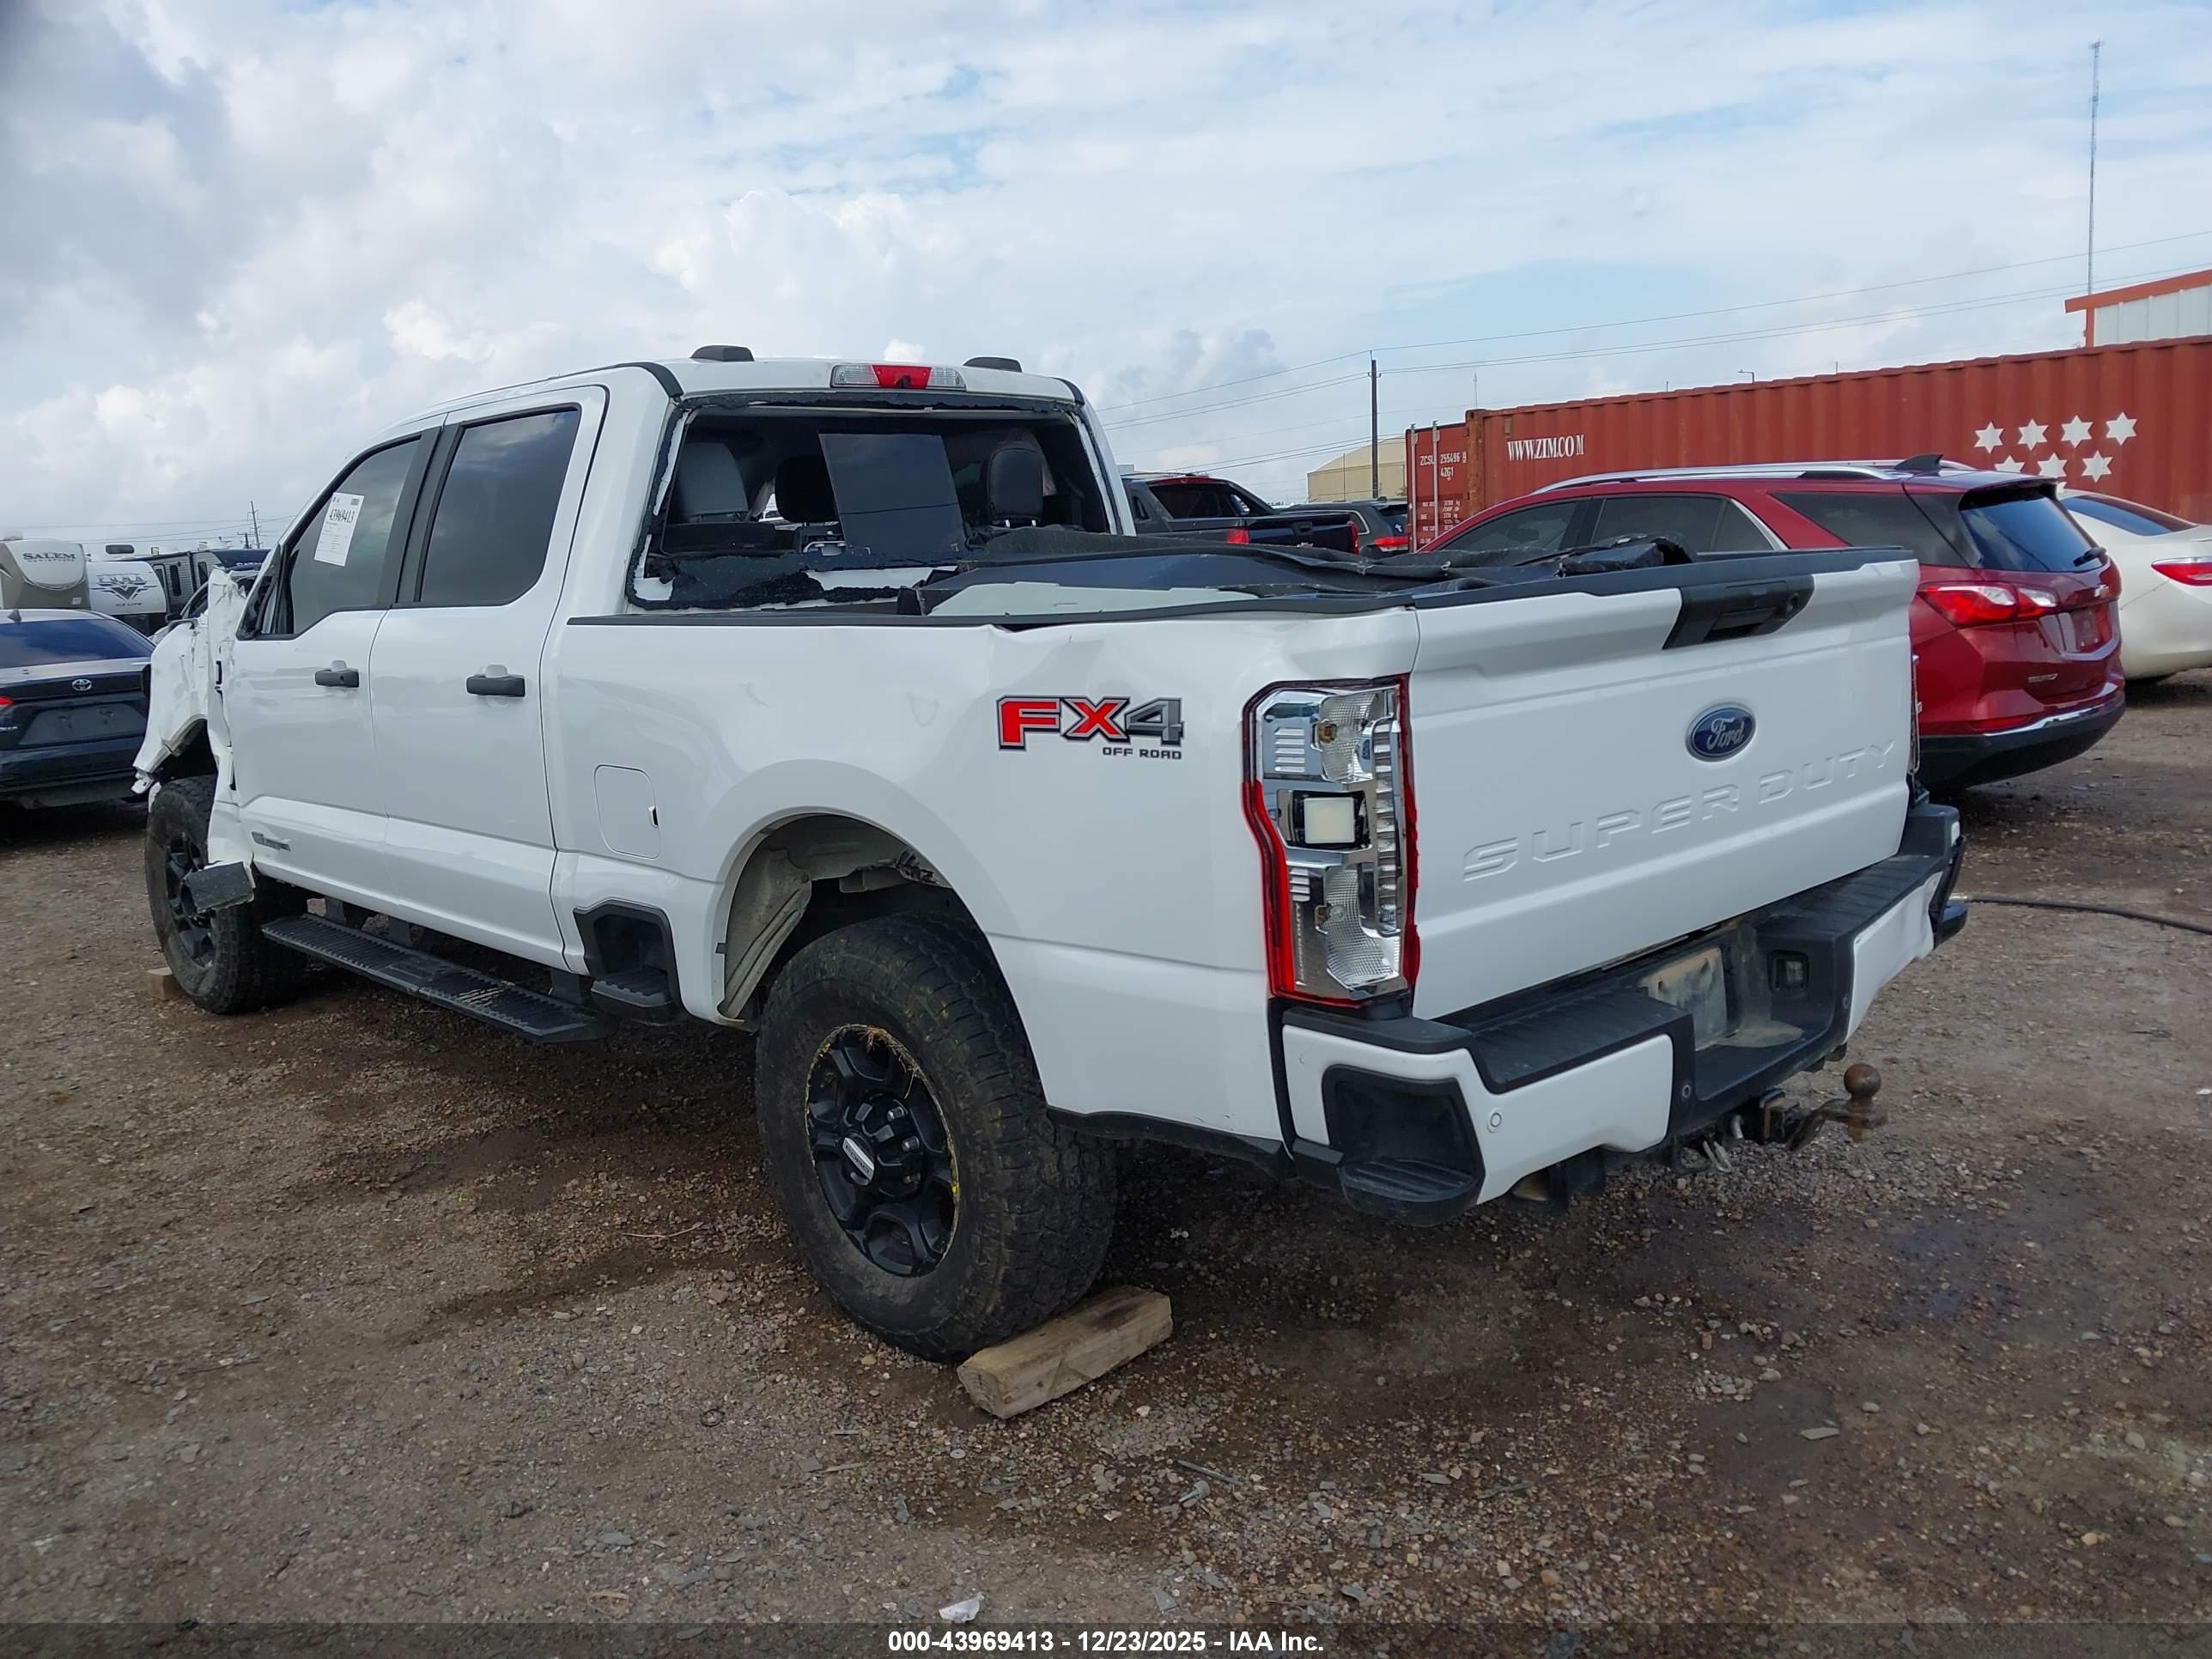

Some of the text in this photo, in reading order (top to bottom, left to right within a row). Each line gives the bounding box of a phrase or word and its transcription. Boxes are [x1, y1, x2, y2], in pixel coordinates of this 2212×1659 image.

[996, 695, 1184, 751] FX4
[1706, 716, 1745, 750] Ford
[1103, 746, 1182, 760] OFF ROAD
[1463, 739, 1895, 883] SUPER DUTY
